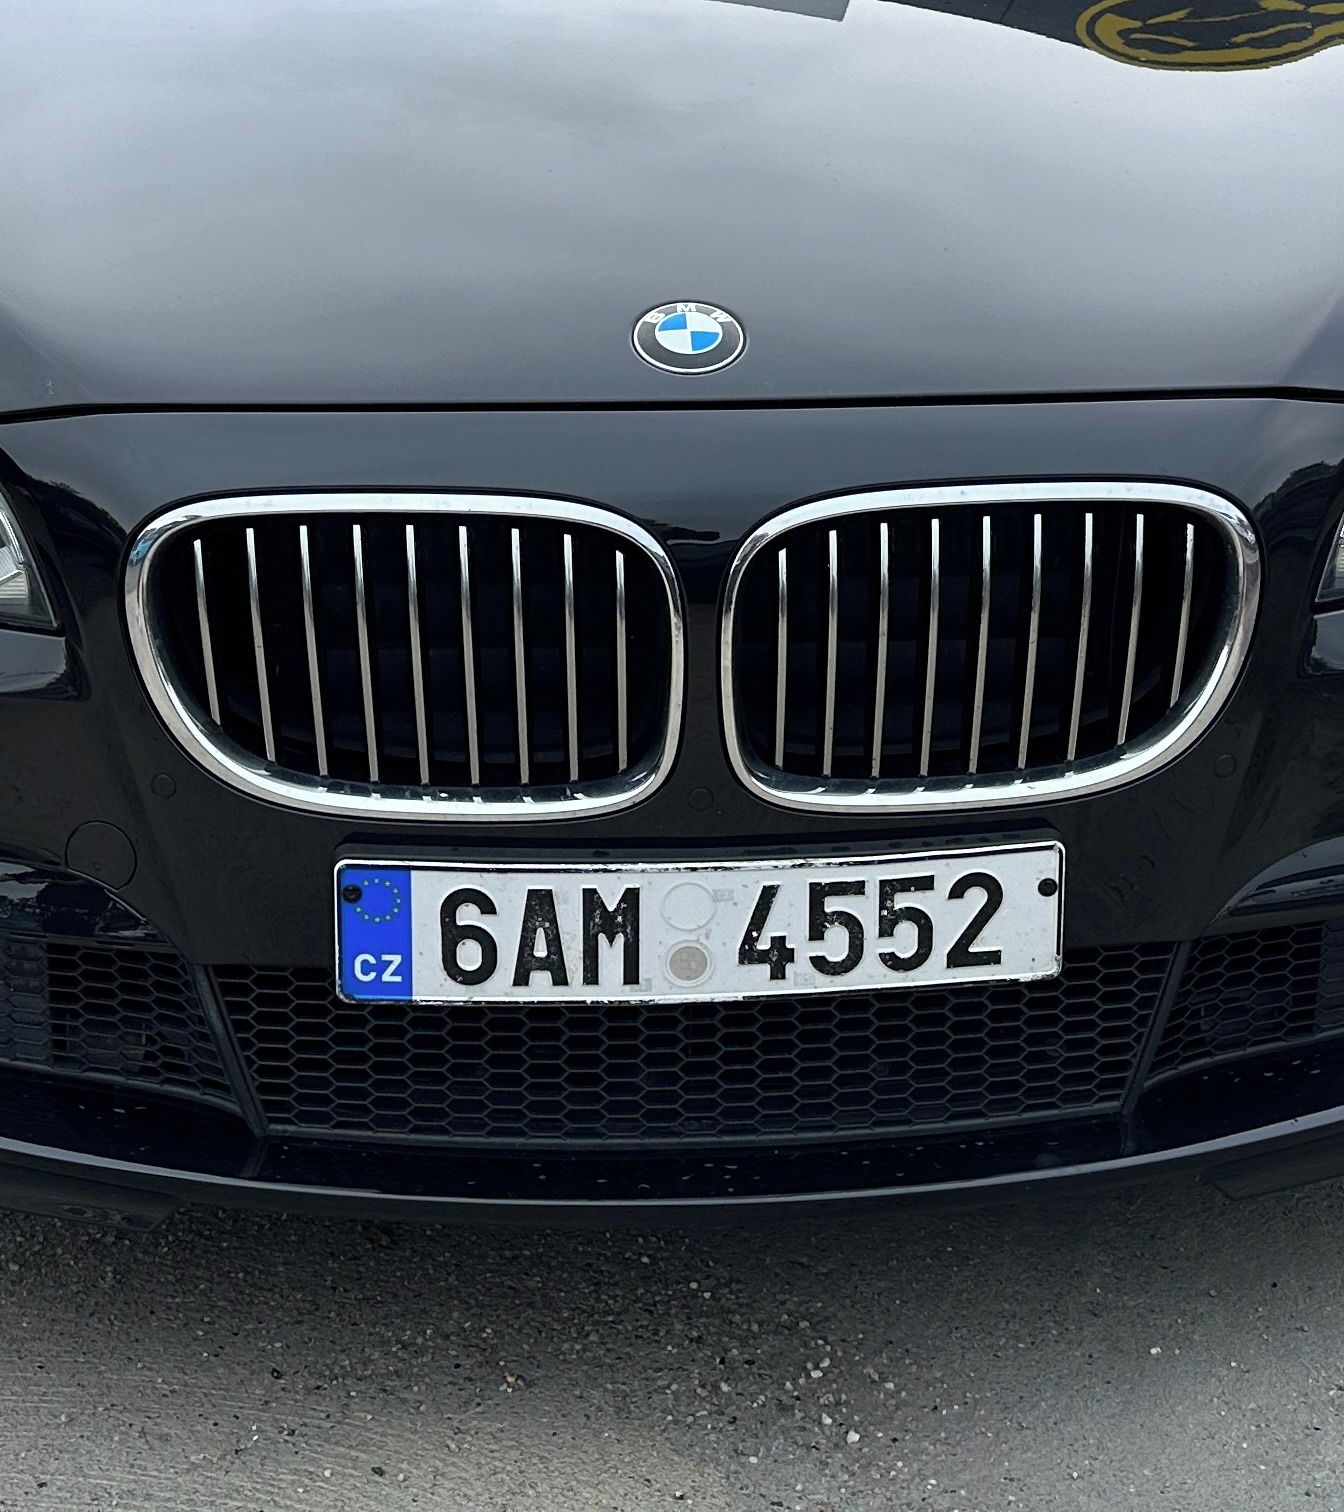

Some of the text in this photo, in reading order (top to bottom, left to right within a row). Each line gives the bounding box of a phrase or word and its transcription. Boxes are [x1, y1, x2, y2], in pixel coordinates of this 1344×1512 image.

[643, 303, 732, 324] BMW
[353, 872, 1005, 987] CZ 6AM 4552
